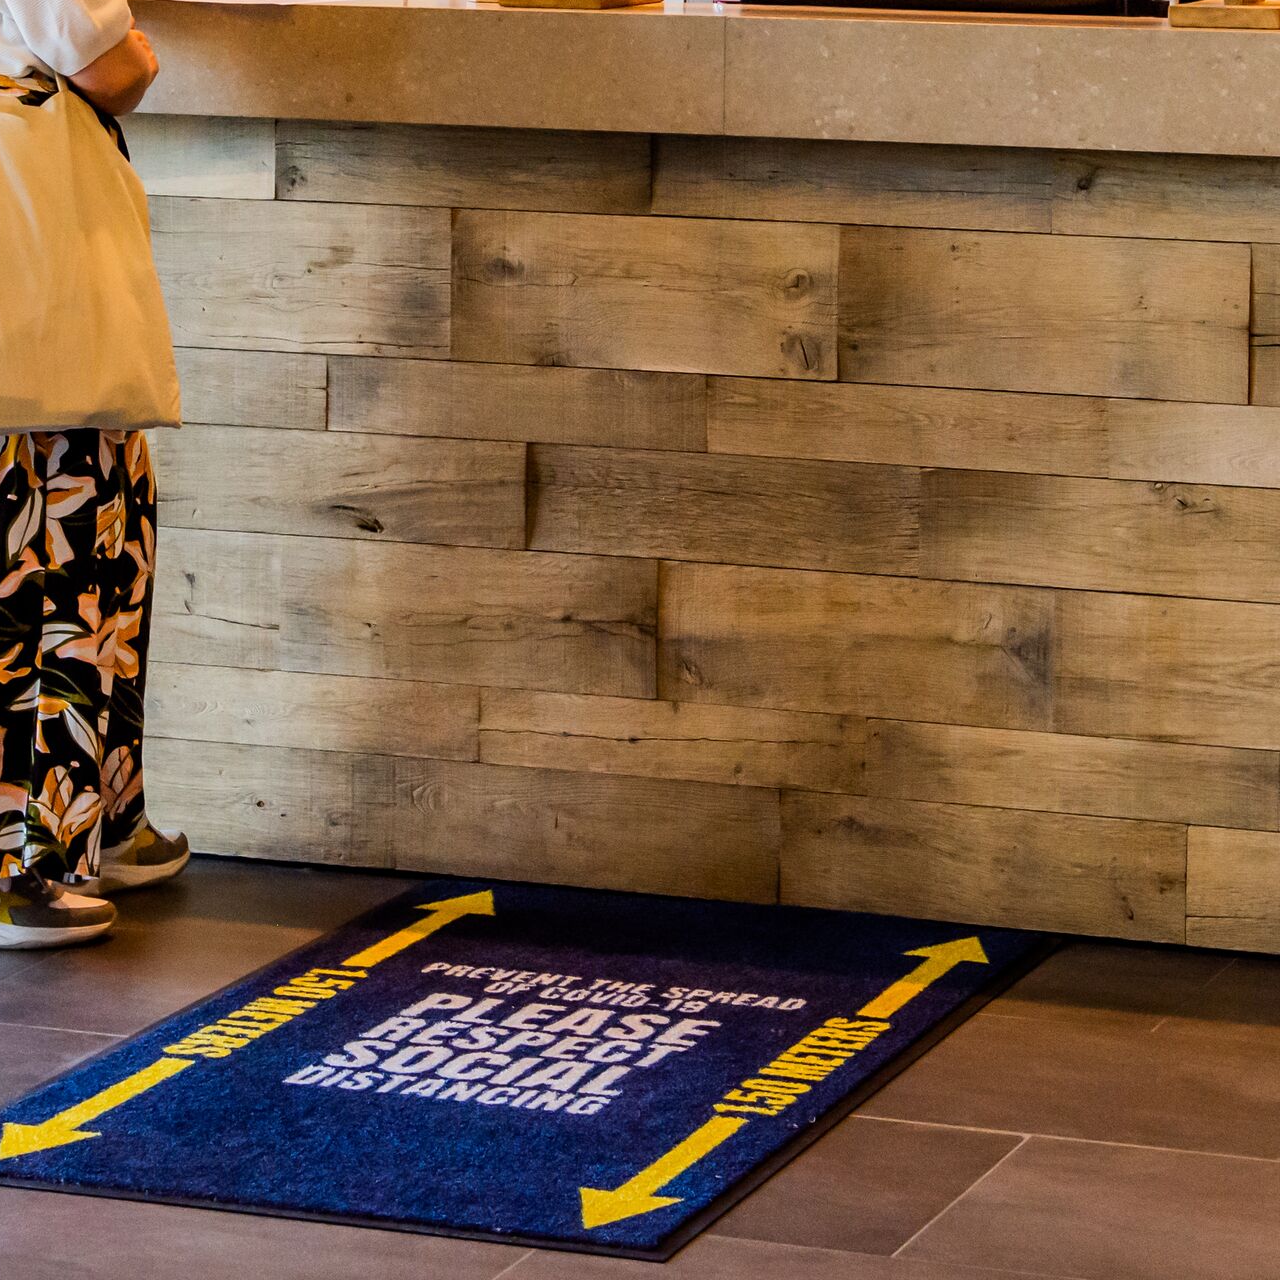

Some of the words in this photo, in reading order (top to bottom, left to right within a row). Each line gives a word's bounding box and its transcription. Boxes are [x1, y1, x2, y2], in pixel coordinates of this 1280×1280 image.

[421, 962, 582, 987] PREVENT
[589, 978, 656, 997] THE
[660, 986, 807, 1011] SPREAD
[483, 981, 537, 995] OF
[538, 986, 709, 1013] COVID-19
[162, 997, 318, 1059] METERS
[359, 1016, 689, 1068] RESPECT
[399, 992, 722, 1047] PLEASE
[322, 1039, 632, 1097] SOCIAL
[758, 1017, 891, 1082] METERS
[282, 1064, 612, 1116] DISTANCING
